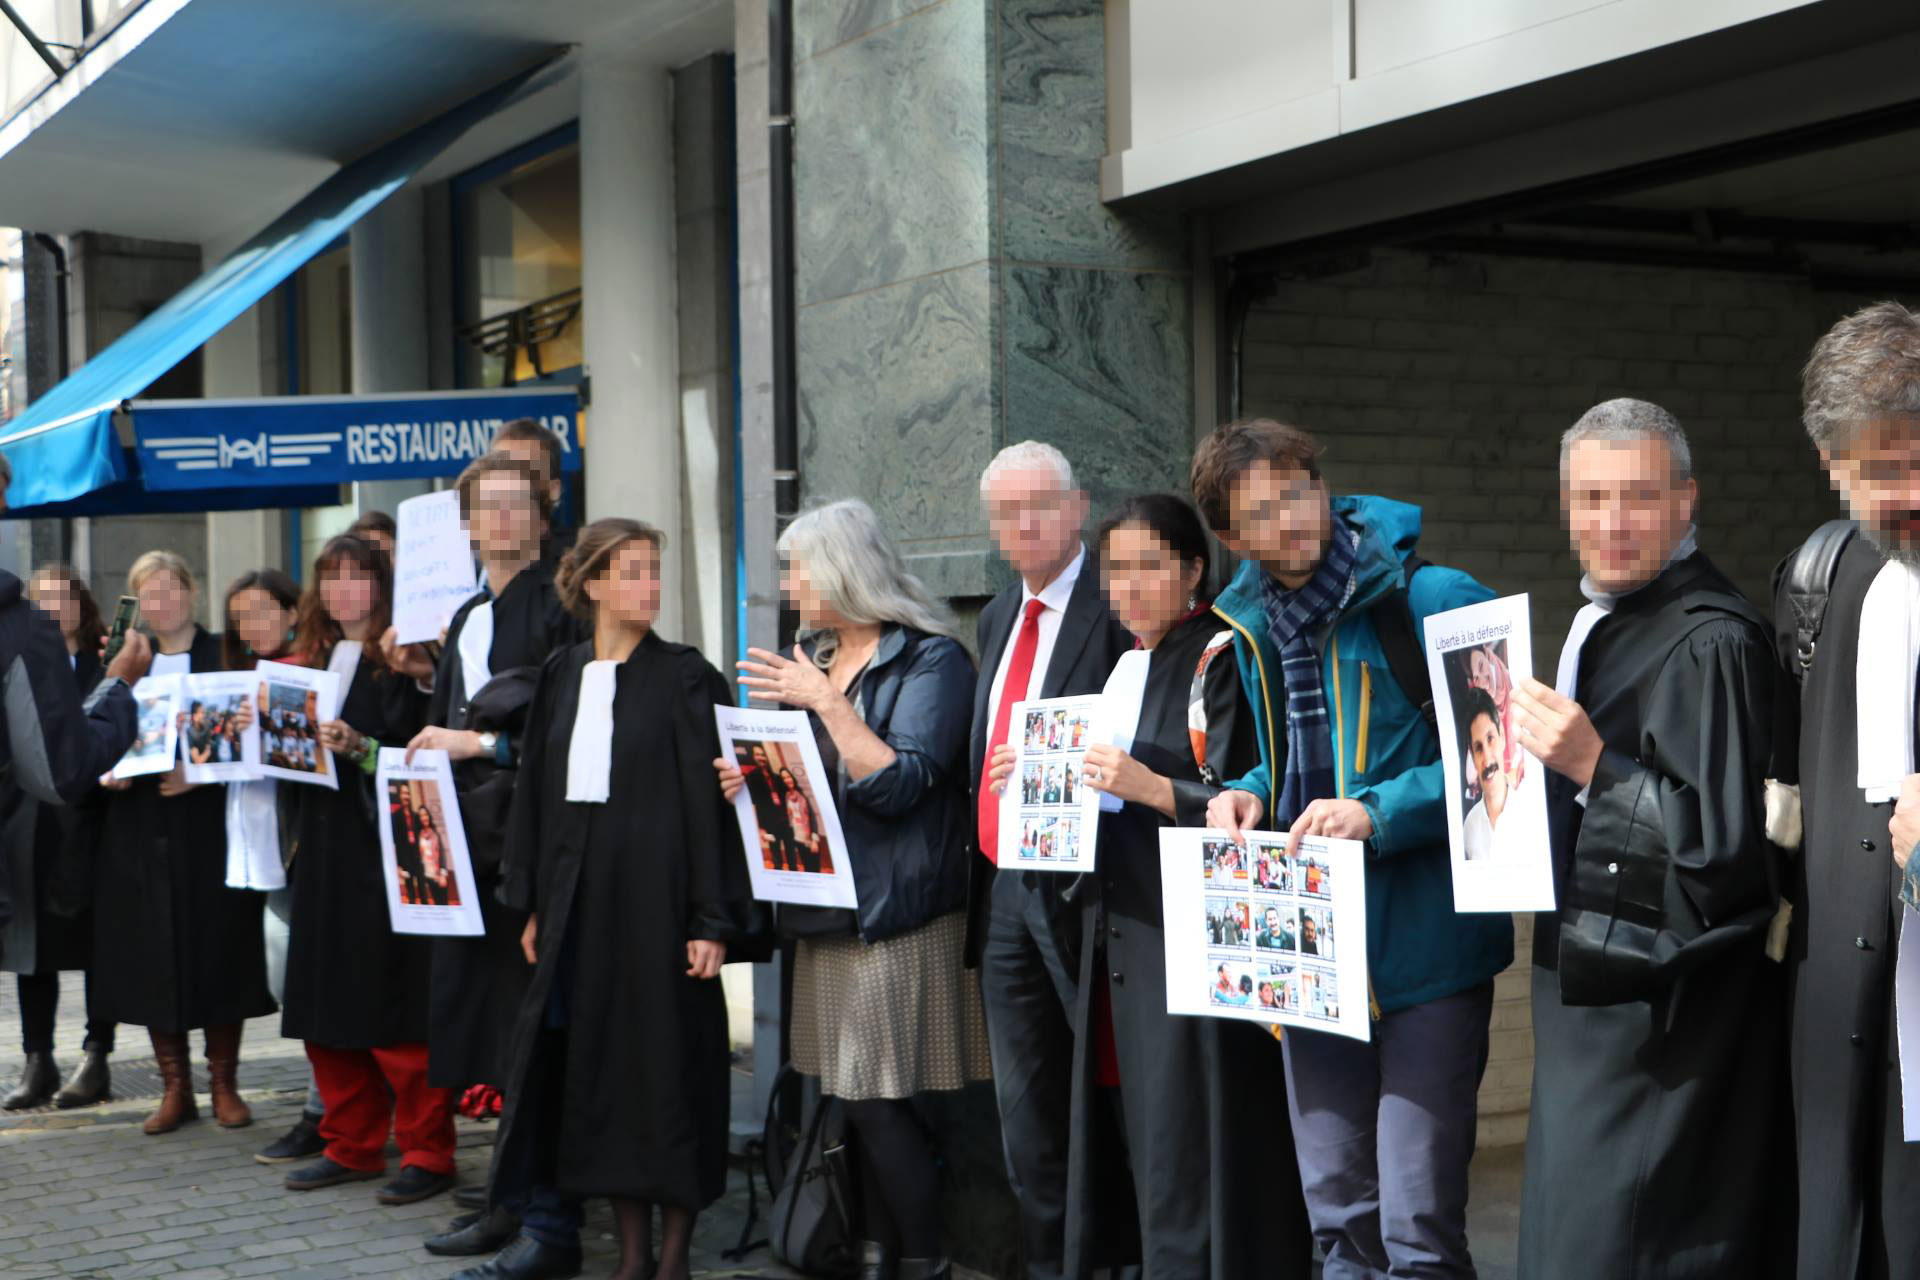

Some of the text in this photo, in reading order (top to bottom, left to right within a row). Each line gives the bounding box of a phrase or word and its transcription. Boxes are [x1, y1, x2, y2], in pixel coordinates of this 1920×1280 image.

[1435, 620, 1513, 650] Liberté à la défense!
